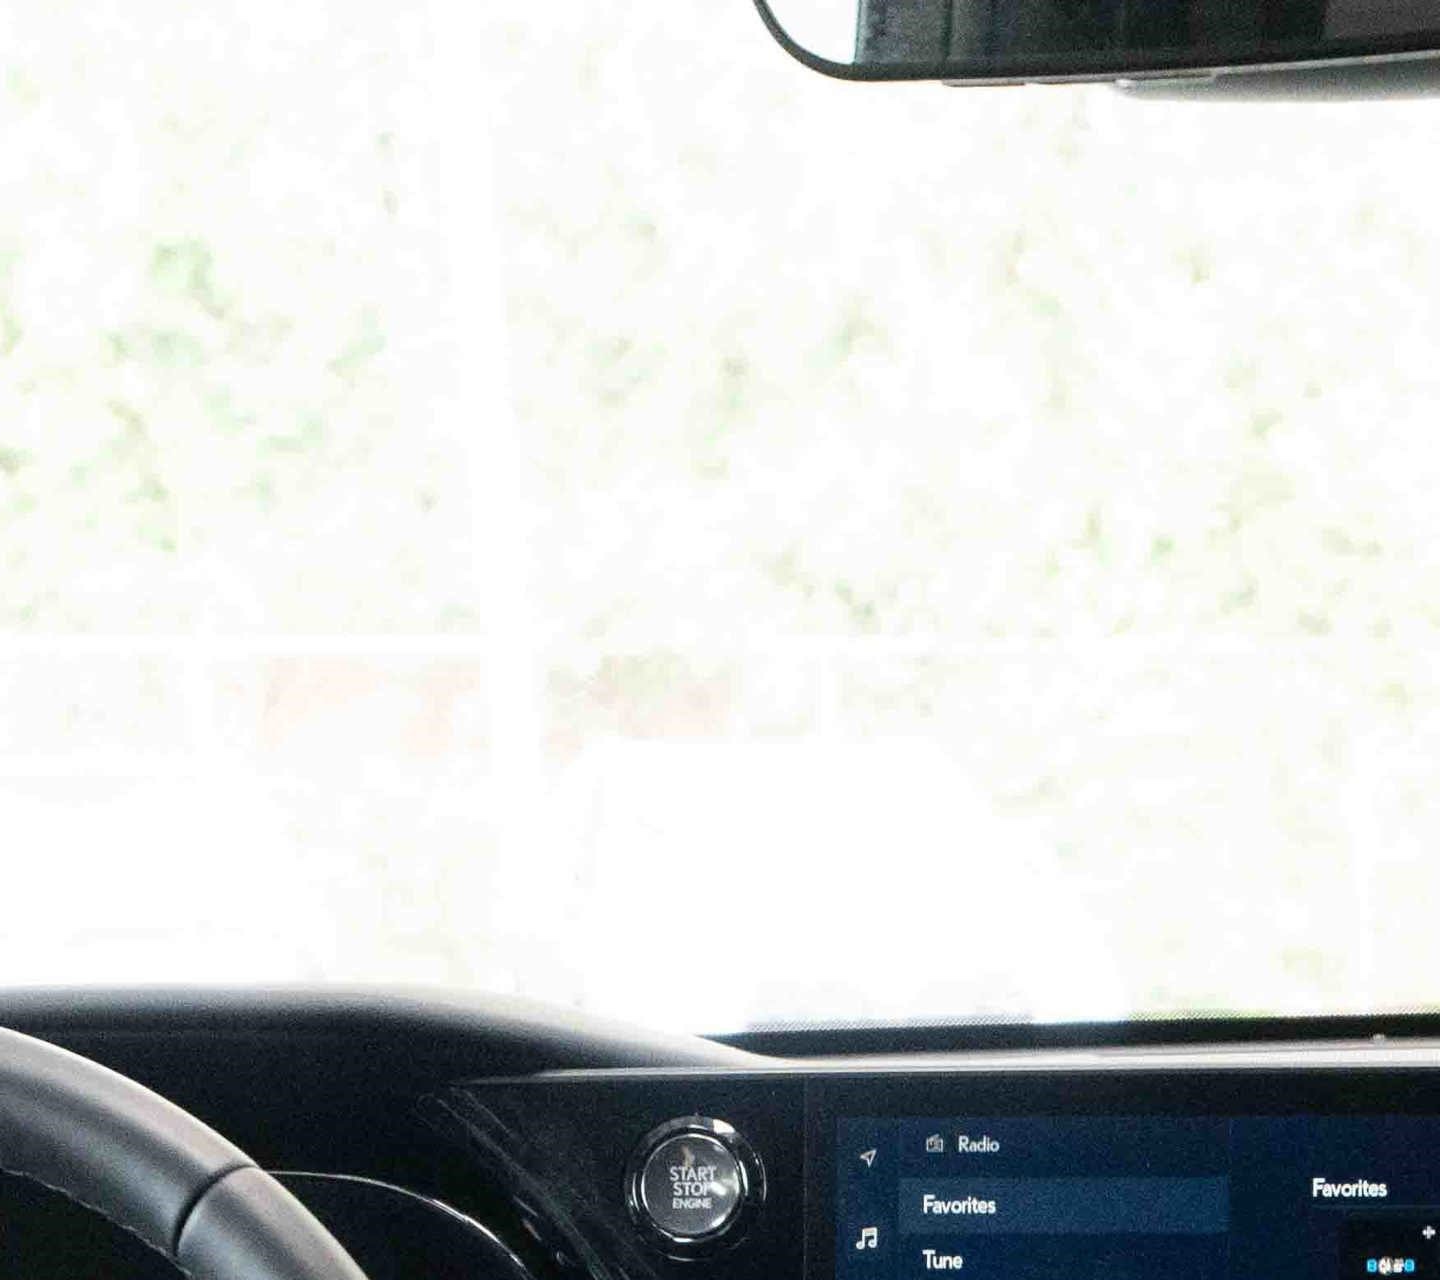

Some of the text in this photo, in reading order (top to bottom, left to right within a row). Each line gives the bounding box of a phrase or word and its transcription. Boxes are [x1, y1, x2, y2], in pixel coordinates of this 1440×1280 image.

[957, 1134, 1001, 1153] Radio
[669, 1165, 716, 1182] START
[1311, 1177, 1388, 1200] Favorites
[922, 1194, 997, 1215] Favorites
[921, 1248, 964, 1270] Tune
